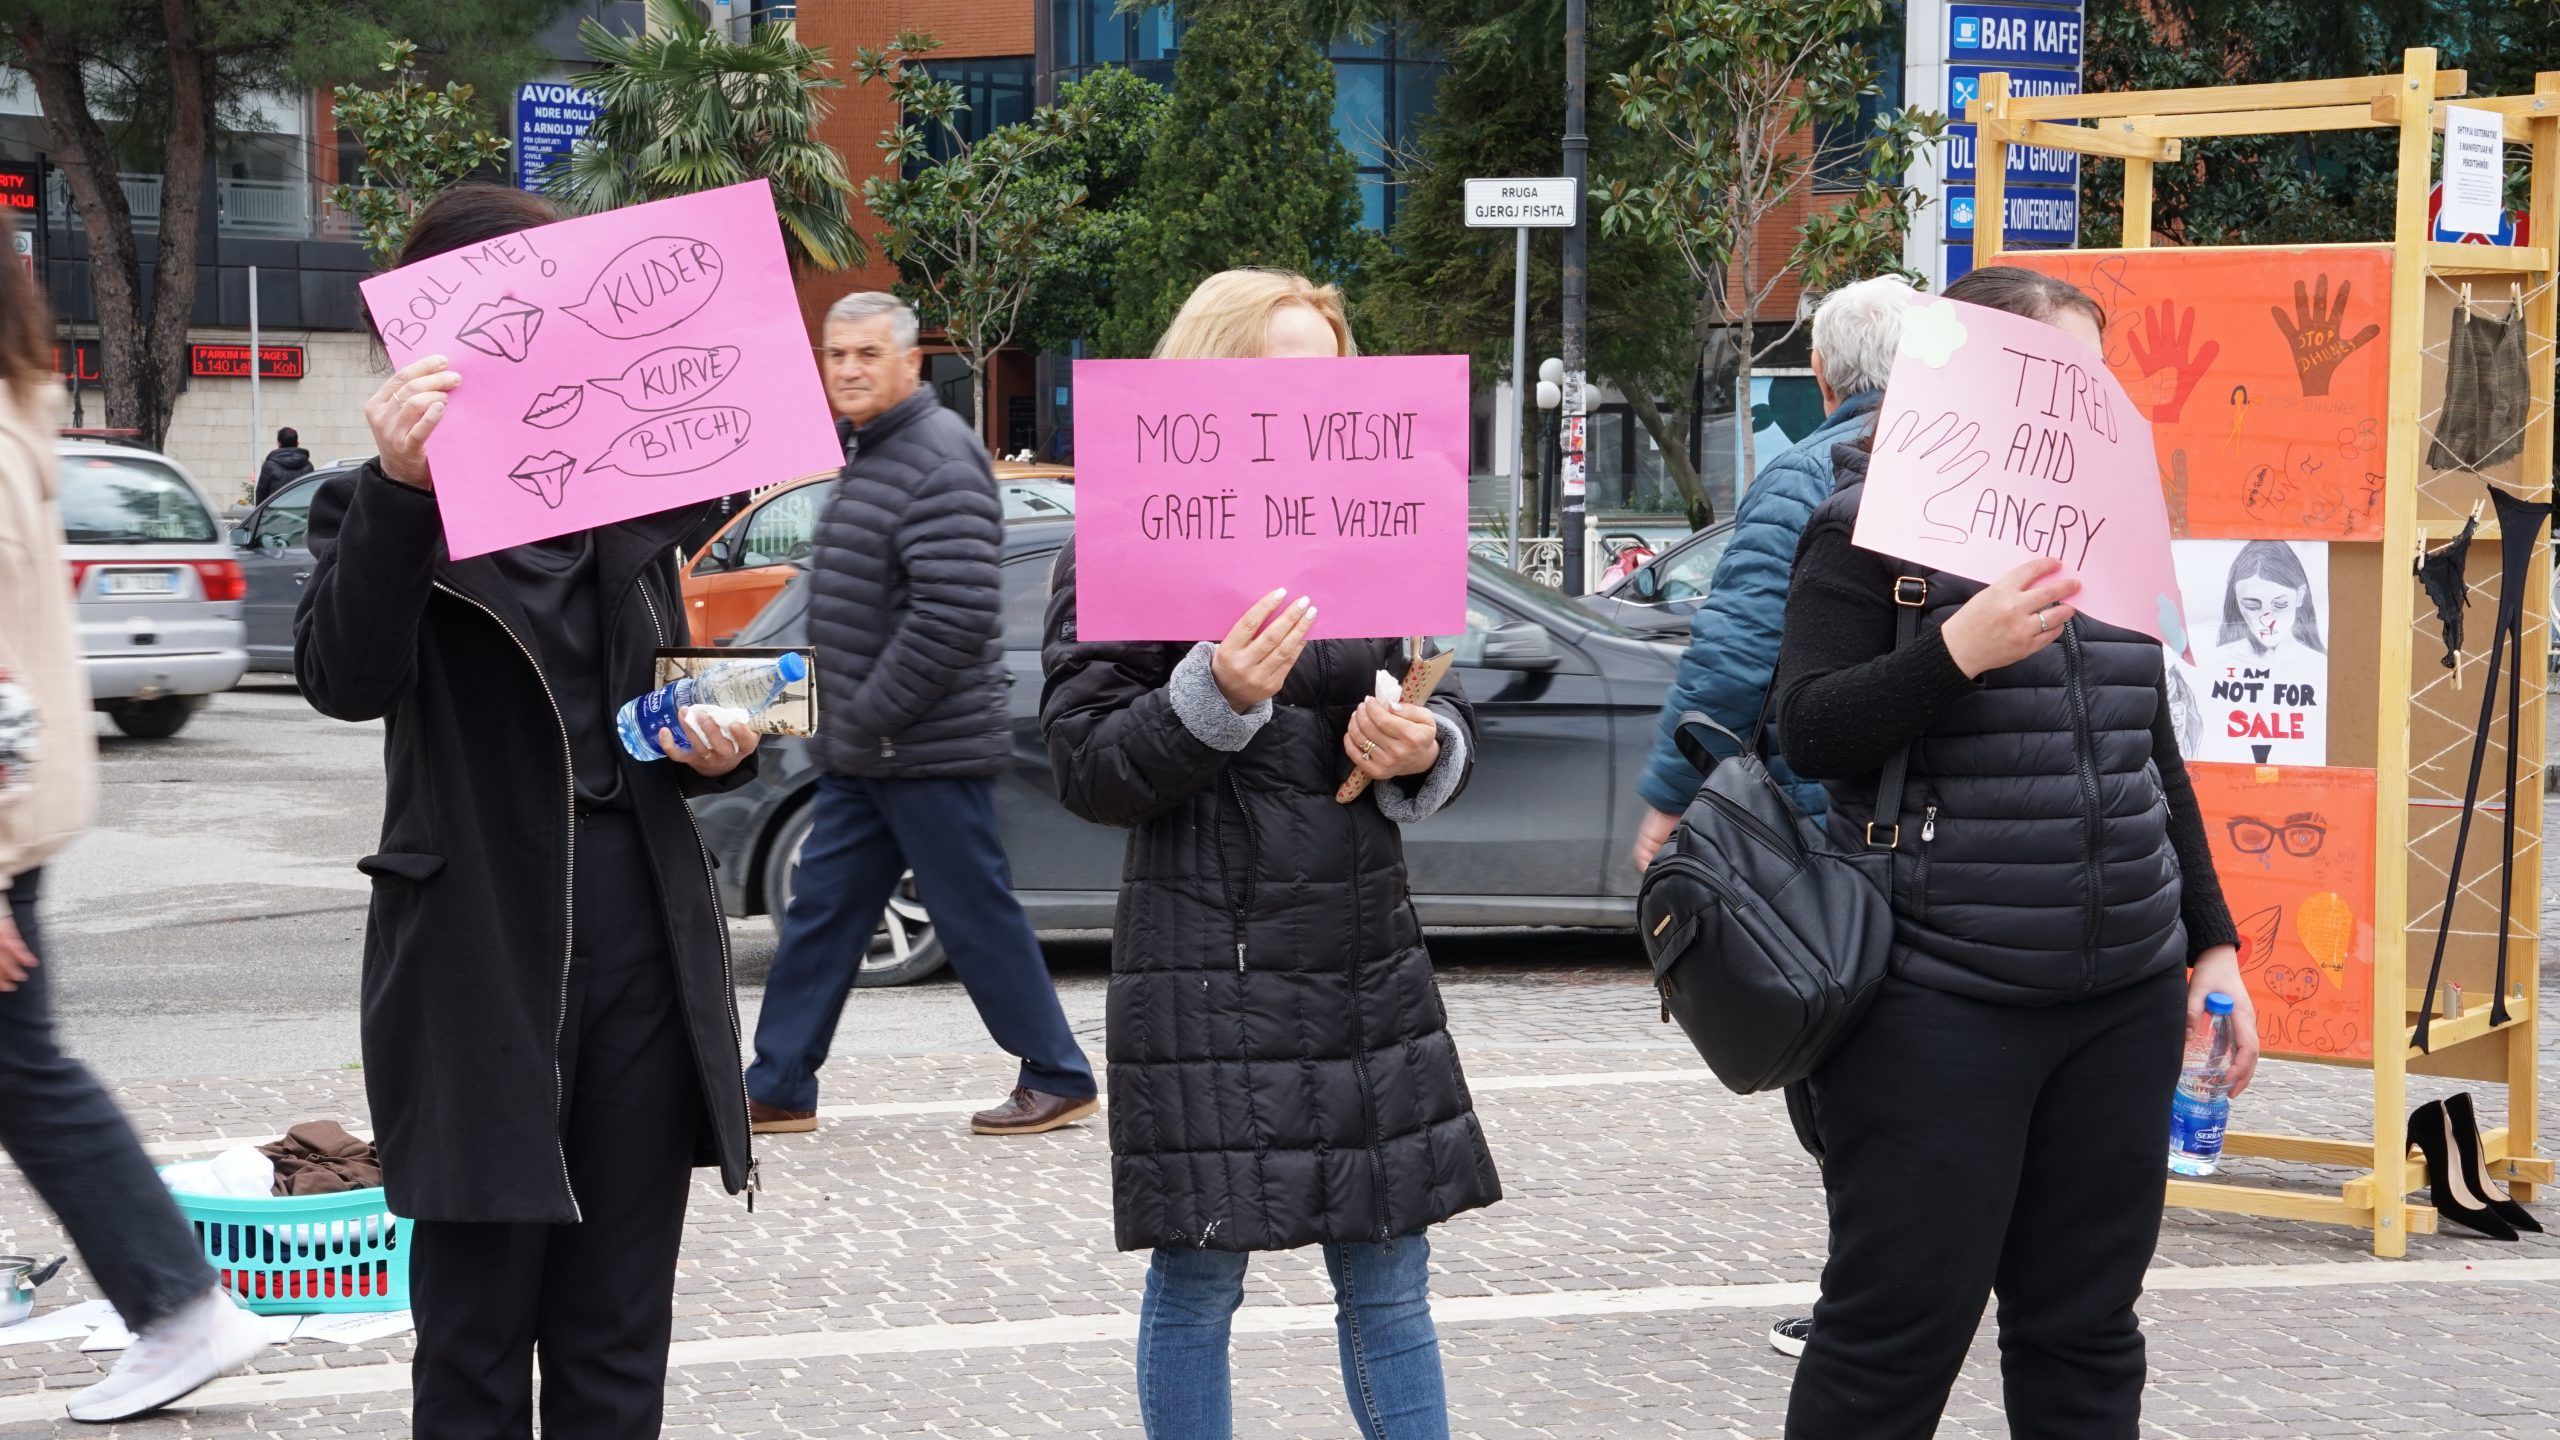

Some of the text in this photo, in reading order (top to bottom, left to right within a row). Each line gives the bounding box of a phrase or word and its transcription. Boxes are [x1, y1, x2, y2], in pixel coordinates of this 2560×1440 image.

[1981, 17, 2078, 54] BAR KAFE
[524, 121, 531, 133] &
[534, 122, 573, 135] ARNOLD
[535, 107, 595, 120] NDRE MOLLA
[1501, 187, 1538, 198] RRUGA
[1475, 205, 1564, 218] GJERGJ FISHTA
[2010, 197, 2073, 232] KONFERENCASH
[384, 276, 462, 352] BOLL
[2298, 329, 2335, 349] STOP
[207, 360, 230, 372] 140
[2003, 346, 2118, 444] TIRED
[629, 410, 745, 462] BITCH!
[1136, 411, 1418, 464] MOS I VRISNI
[2004, 422, 2074, 484] AND
[1141, 488, 1426, 541] GRATË DHE VAJZAT
[1970, 487, 2106, 572] ANGRY
[2226, 667, 2271, 679] I AM
[2211, 680, 2317, 707] NOT FOR
[2227, 709, 2305, 739] SALE
